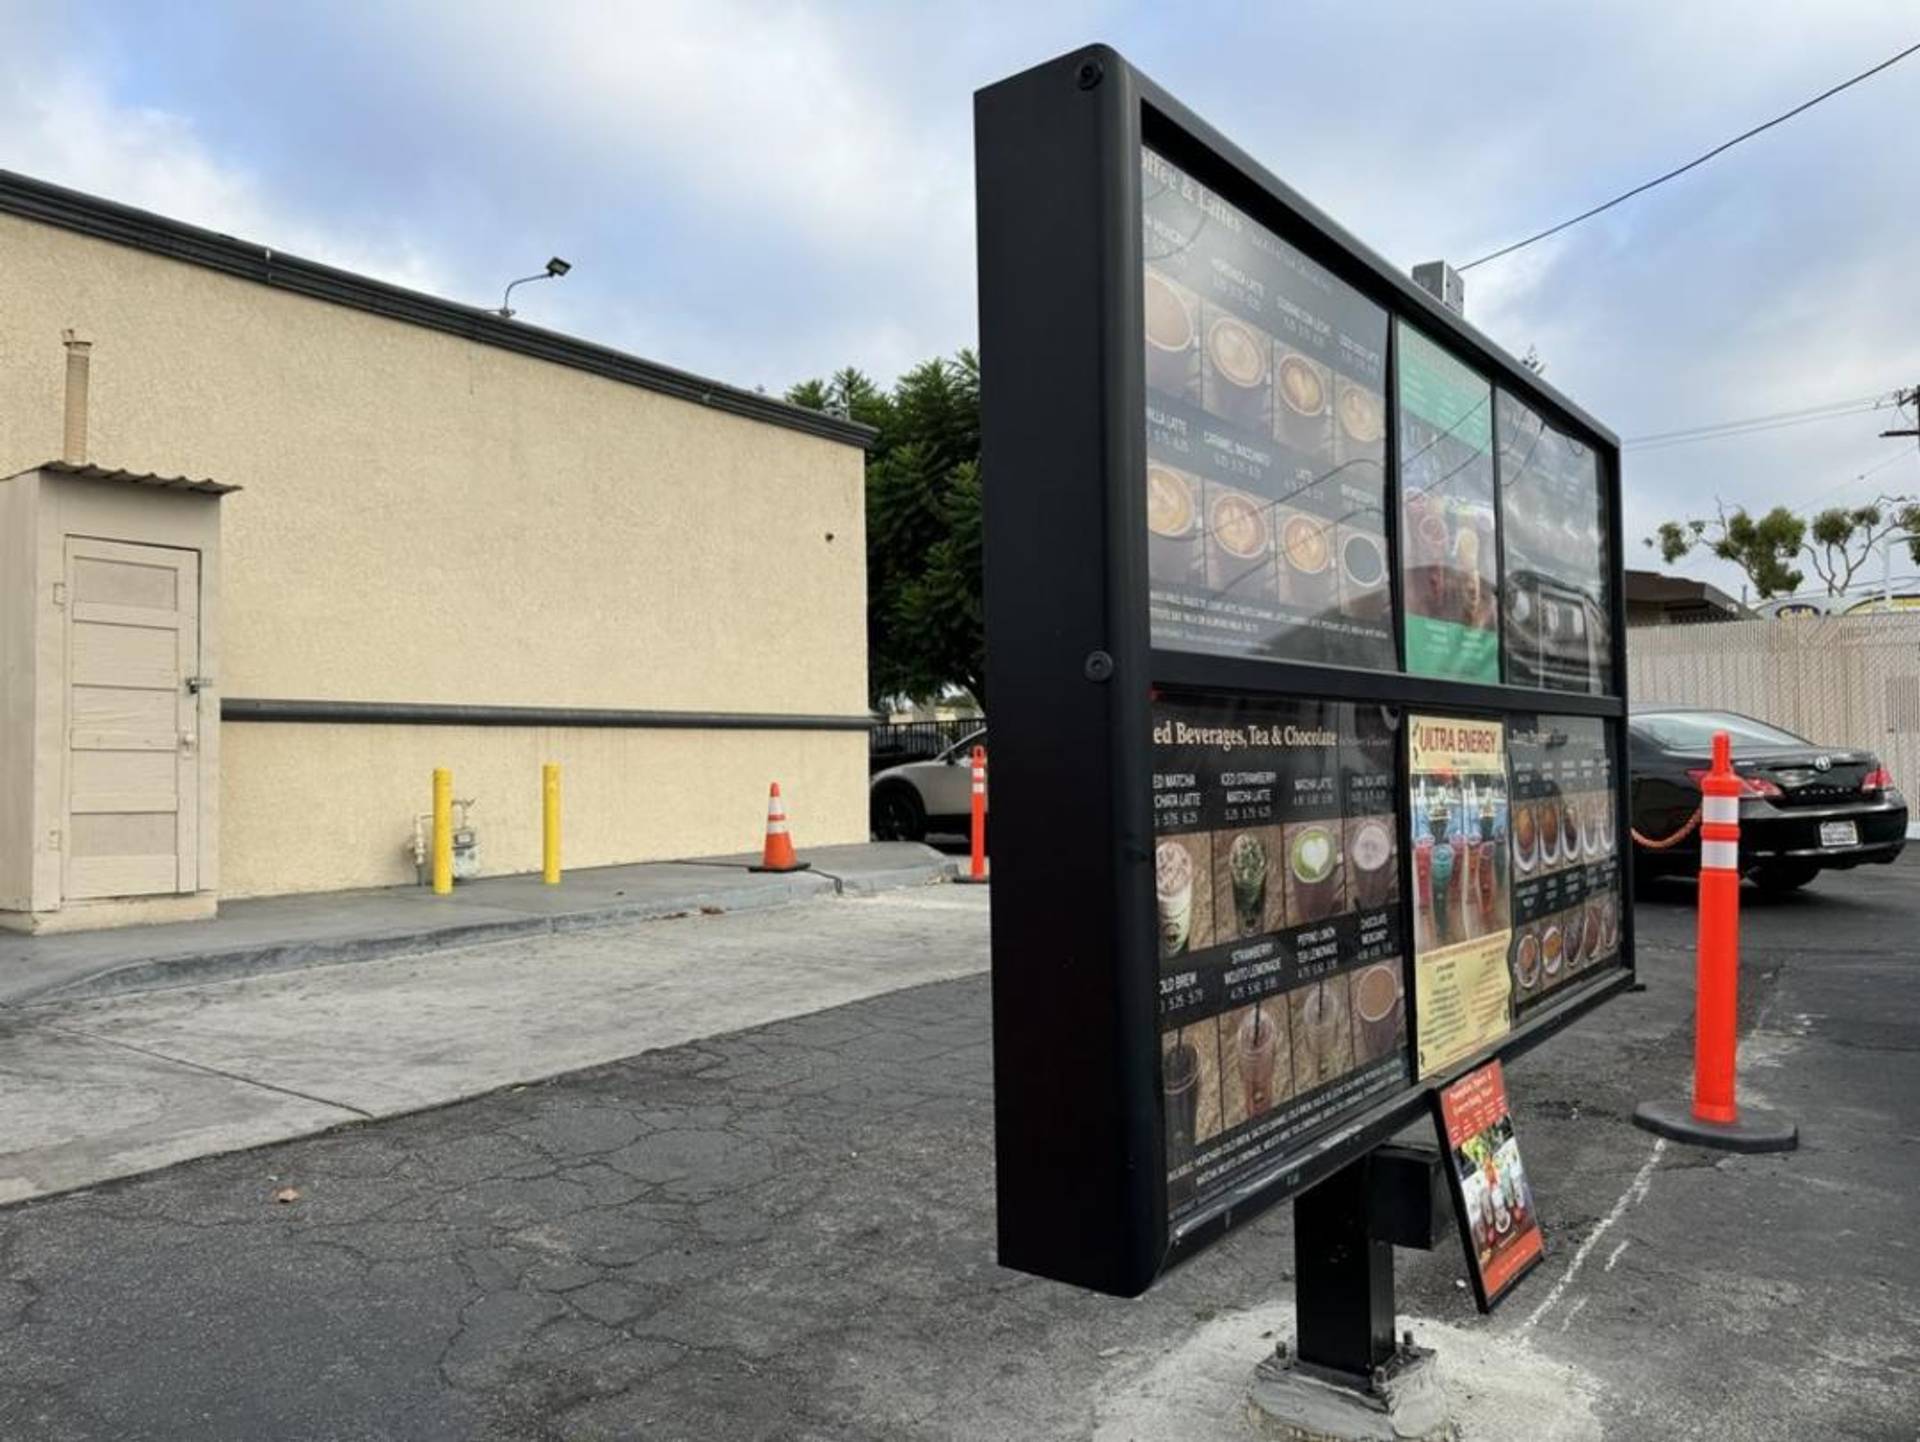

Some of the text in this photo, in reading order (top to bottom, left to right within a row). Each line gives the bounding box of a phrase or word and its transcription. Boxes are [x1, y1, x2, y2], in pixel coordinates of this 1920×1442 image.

[1176, 722, 1247, 751] Beverages,
[1248, 724, 1270, 746] Tea
[1271, 726, 1282, 746] &
[1284, 724, 1337, 746] Chocolate
[1419, 726, 1455, 752] ULTRA
[1458, 728, 1496, 754] ENERGY
